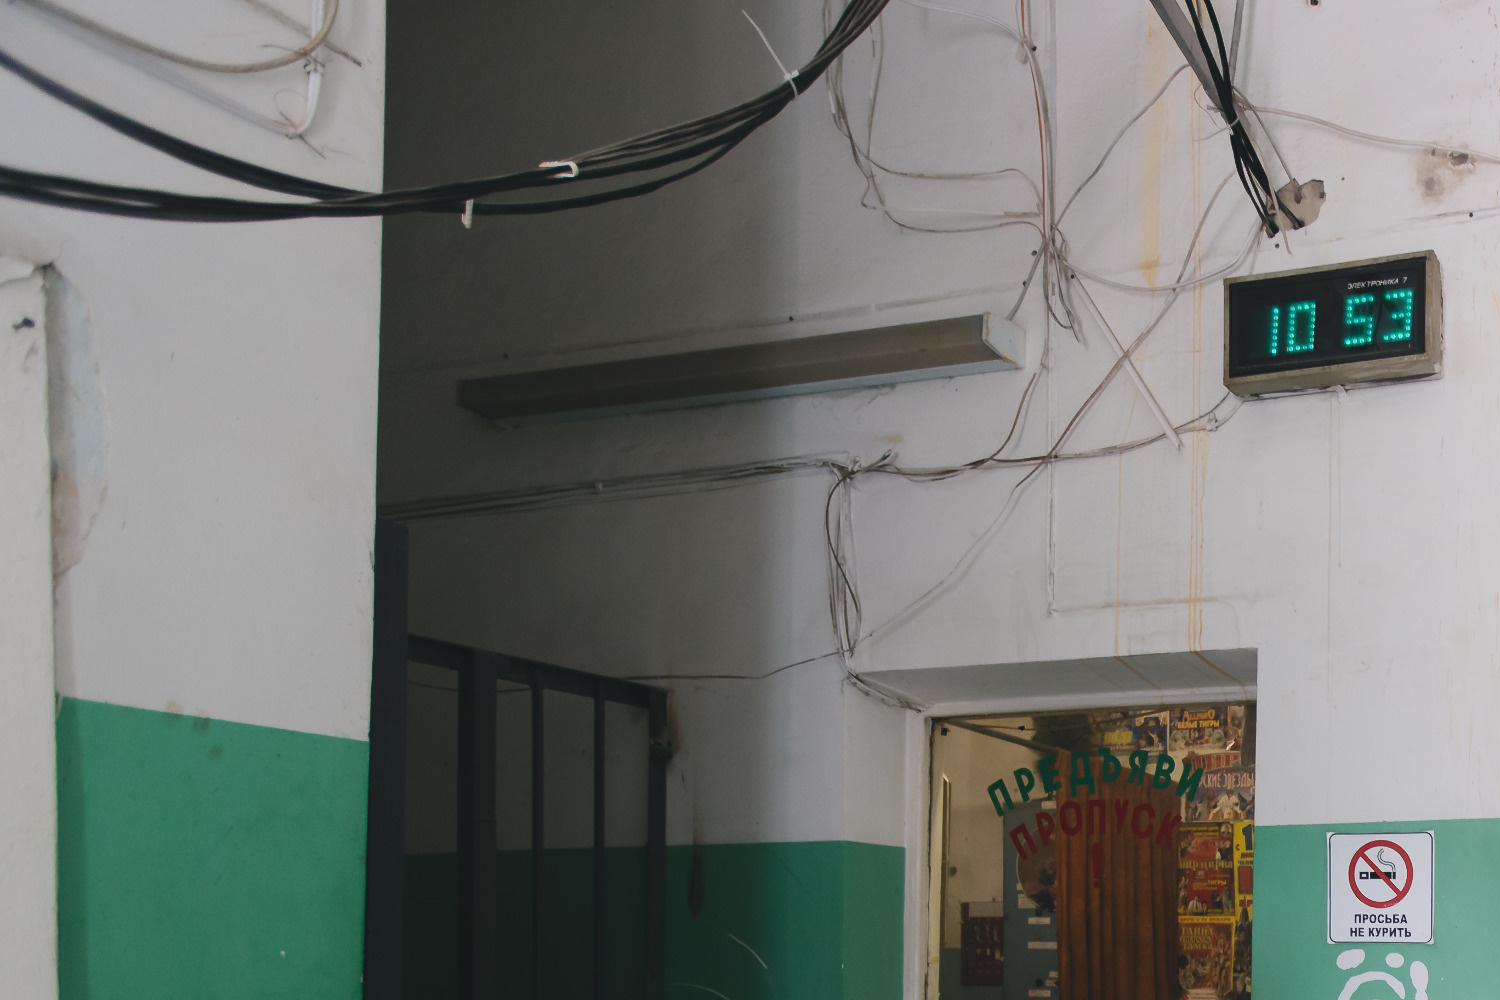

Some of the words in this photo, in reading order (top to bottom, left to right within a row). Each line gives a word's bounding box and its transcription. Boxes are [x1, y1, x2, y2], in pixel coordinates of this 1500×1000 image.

[1347, 277, 1399, 290] ЭЛЕКТРОНИКА
[1402, 276, 1408, 284] 7
[1269, 301, 1317, 356] 10
[1344, 288, 1414, 347] 53
[1199, 719, 1220, 728] ТИГРЫ
[987, 748, 1205, 816] ПРЕДЪЯВИ
[1009, 799, 1182, 861] ПРОПУСК
[1354, 914, 1408, 924] ПРОСЬБА
[1350, 927, 1365, 938] НЕ
[1368, 927, 1412, 938] КУРИТЬ
